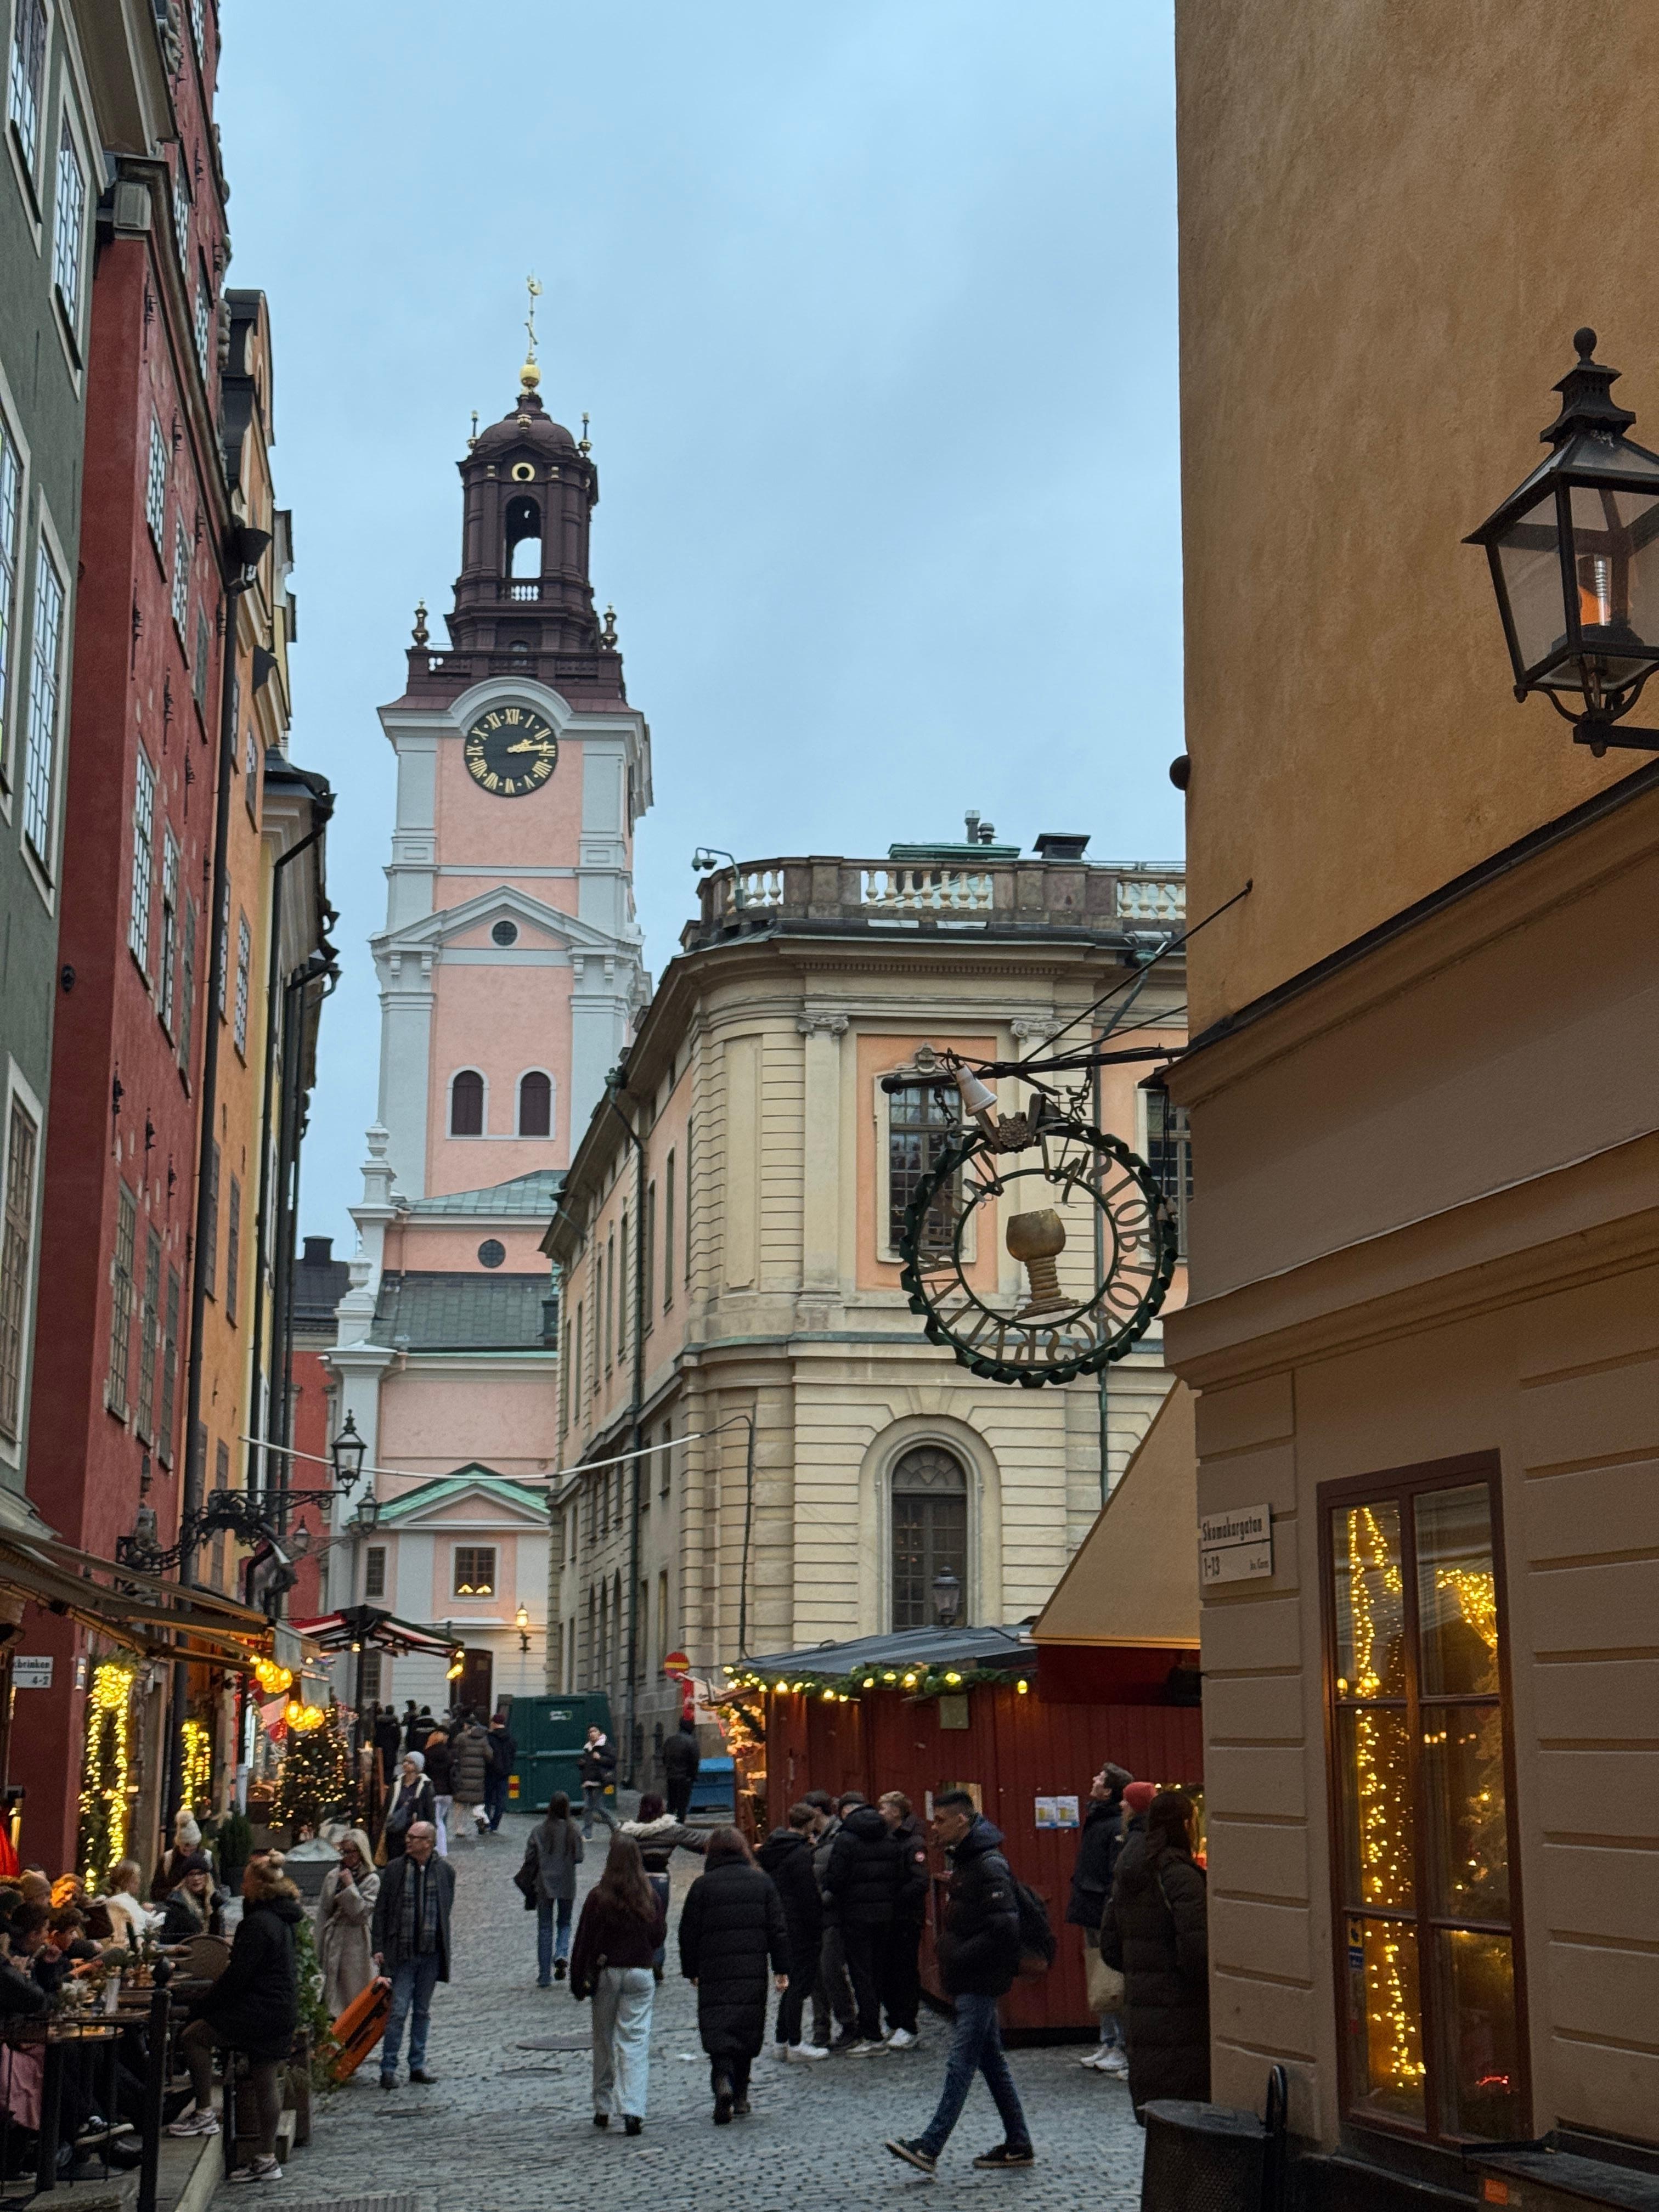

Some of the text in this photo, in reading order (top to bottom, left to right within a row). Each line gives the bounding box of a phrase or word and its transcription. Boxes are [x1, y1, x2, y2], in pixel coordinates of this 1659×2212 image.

[486, 712, 502, 730] XI
[505, 709, 520, 725] XII
[524, 714, 535, 729] I
[471, 727, 489, 741] X
[534, 728, 551, 740] II
[523, 775, 535, 789] V
[1203, 1516, 1262, 1542] Skomakargatan
[13, 1658, 50, 1668] brinken
